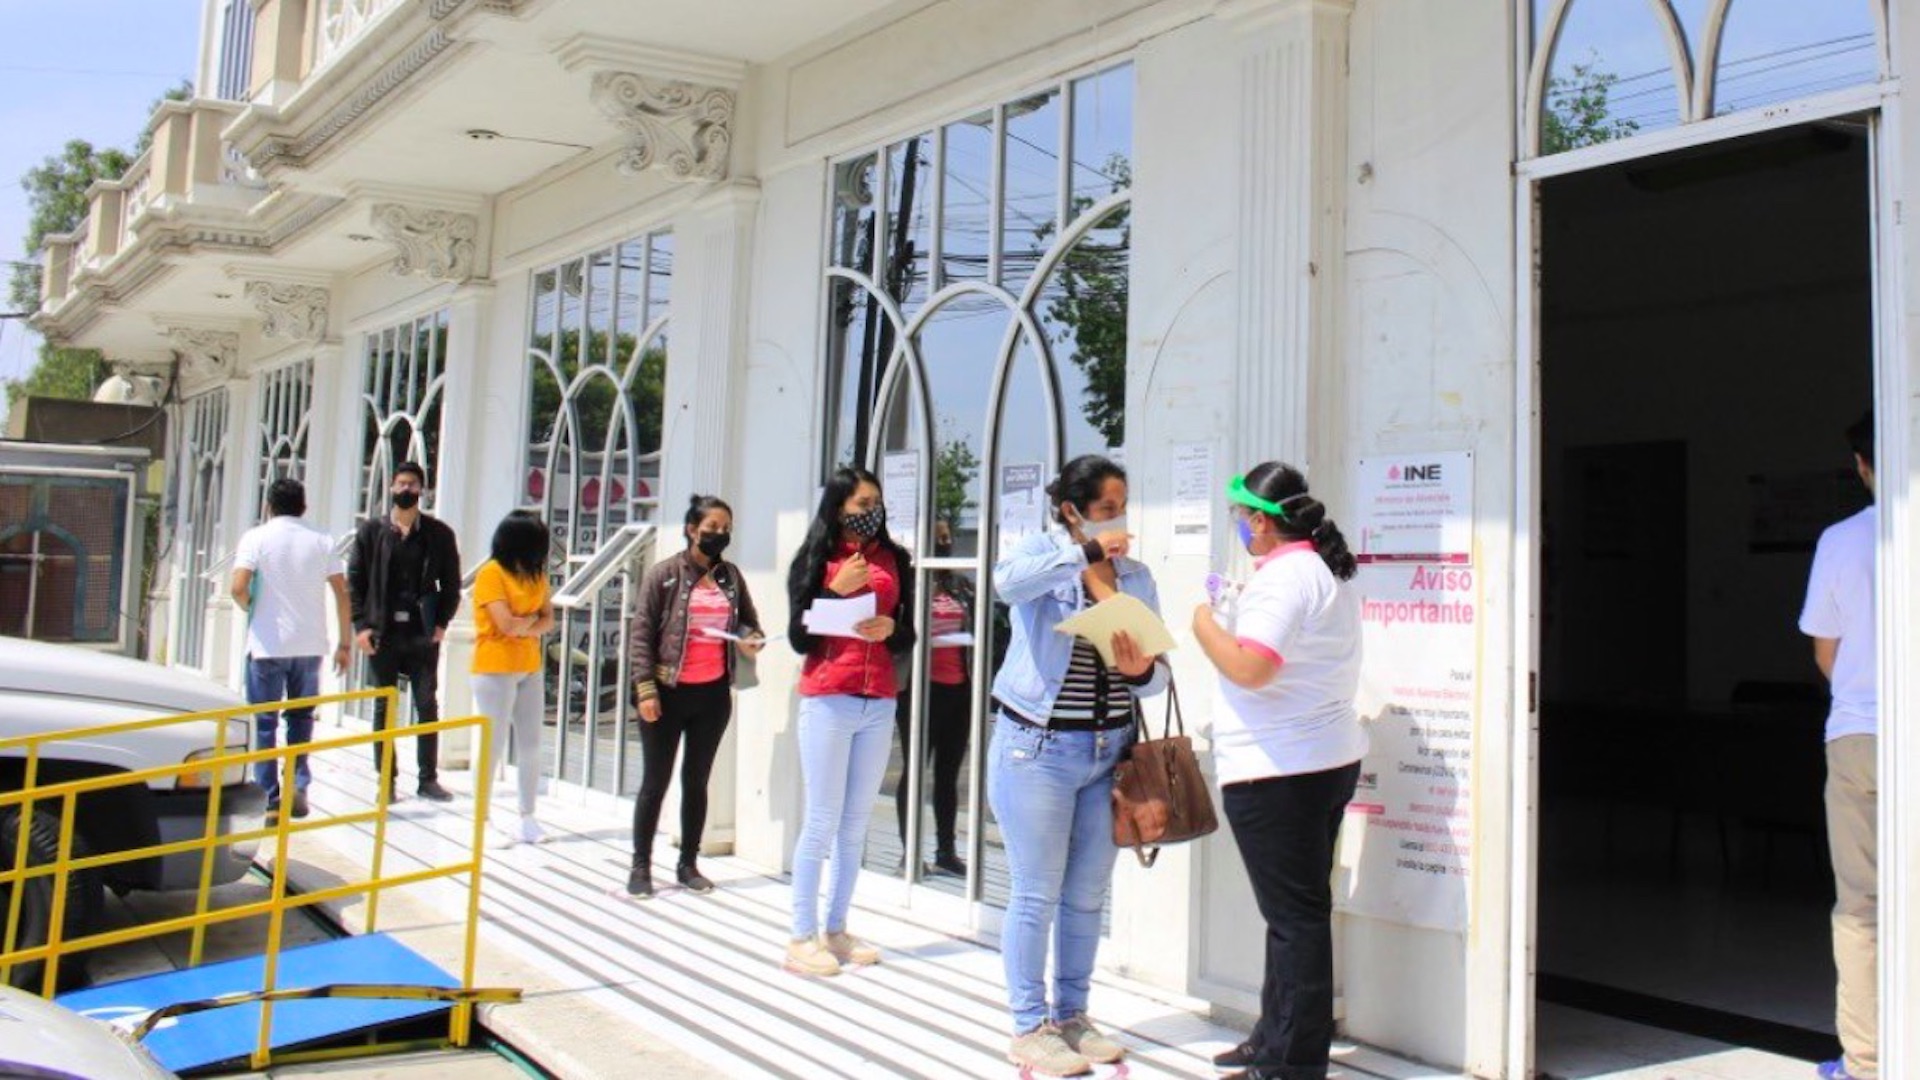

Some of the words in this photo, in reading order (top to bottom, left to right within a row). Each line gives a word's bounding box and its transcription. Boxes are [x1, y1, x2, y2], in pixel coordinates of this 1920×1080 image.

[1404, 464, 1442, 481] INE
[1410, 565, 1472, 592] Aviso
[1361, 598, 1474, 629] Importante
